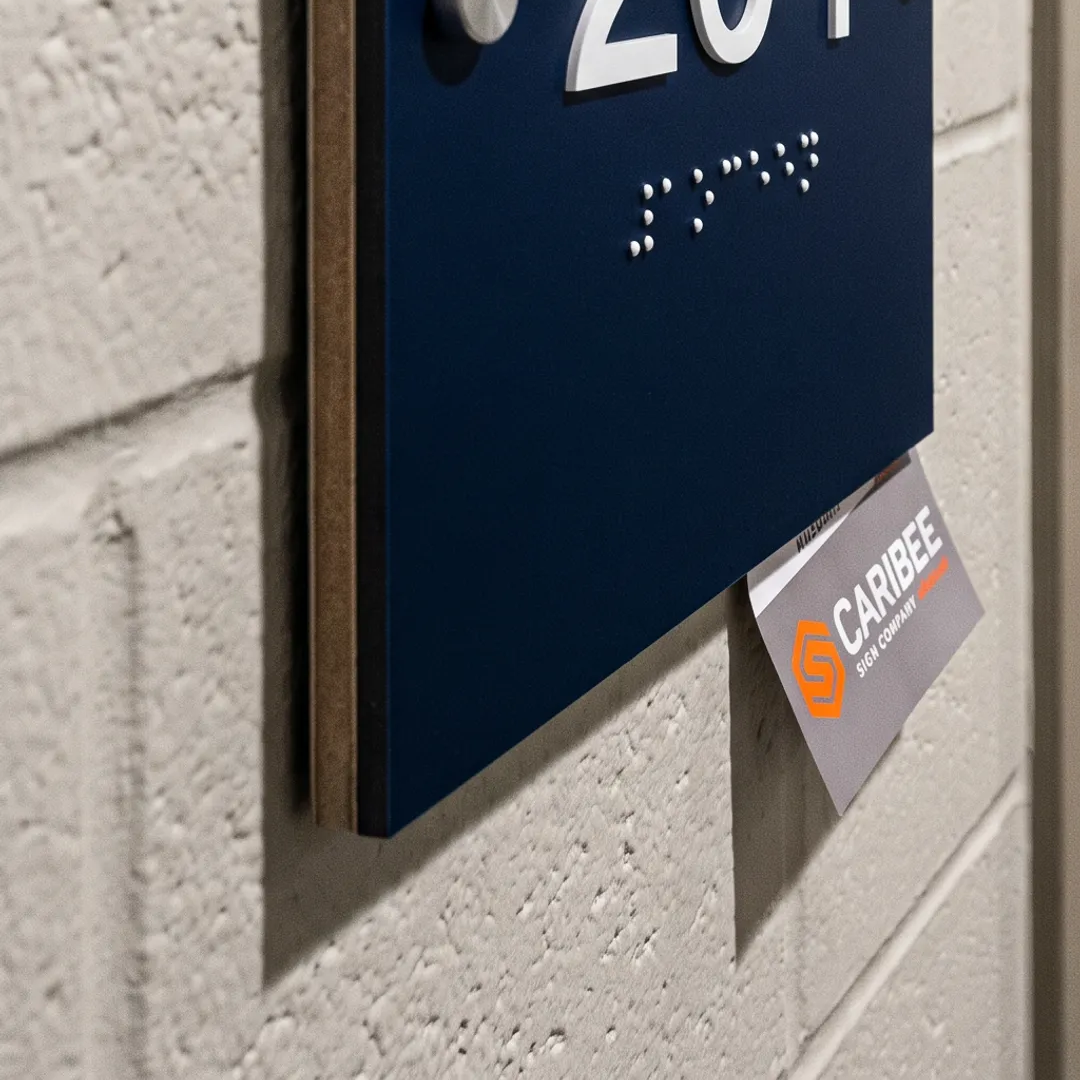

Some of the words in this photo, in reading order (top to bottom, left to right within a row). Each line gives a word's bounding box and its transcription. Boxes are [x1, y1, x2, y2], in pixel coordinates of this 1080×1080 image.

[833, 506, 943, 655] CARIBEE
[856, 644, 880, 678] SIGN
[878, 594, 917, 650] COMPANY
